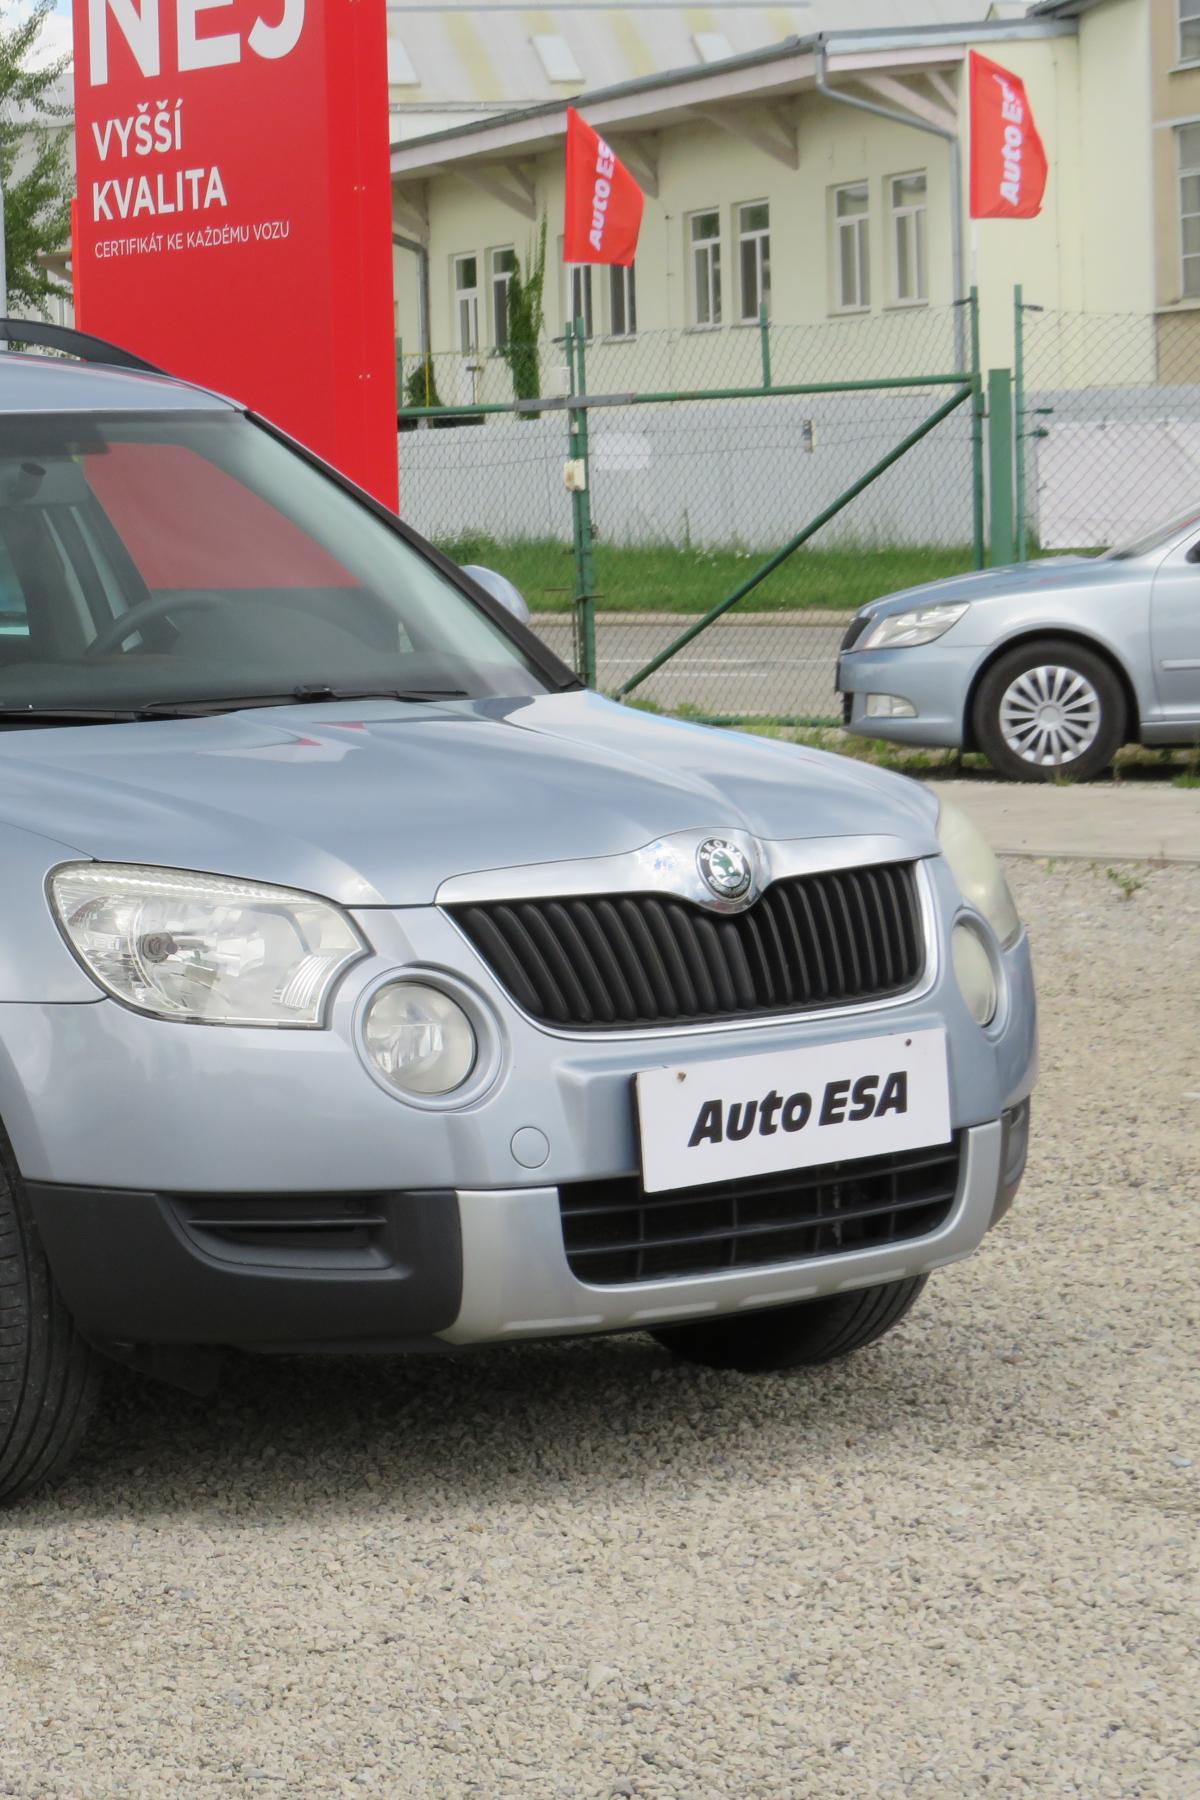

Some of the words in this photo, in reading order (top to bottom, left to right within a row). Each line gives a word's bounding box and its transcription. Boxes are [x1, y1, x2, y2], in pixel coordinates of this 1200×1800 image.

[92, 98, 183, 161] VYŠŠÍ
[92, 166, 227, 222] KVALITA
[1000, 125, 1023, 207] Auto
[94, 234, 163, 259] CERTIFIKÁT
[167, 232, 184, 250] KE
[187, 224, 249, 249] KAŽDÉMU
[253, 221, 290, 241] VOZU
[687, 1090, 812, 1147] Auto
[819, 1071, 908, 1127] ESA
